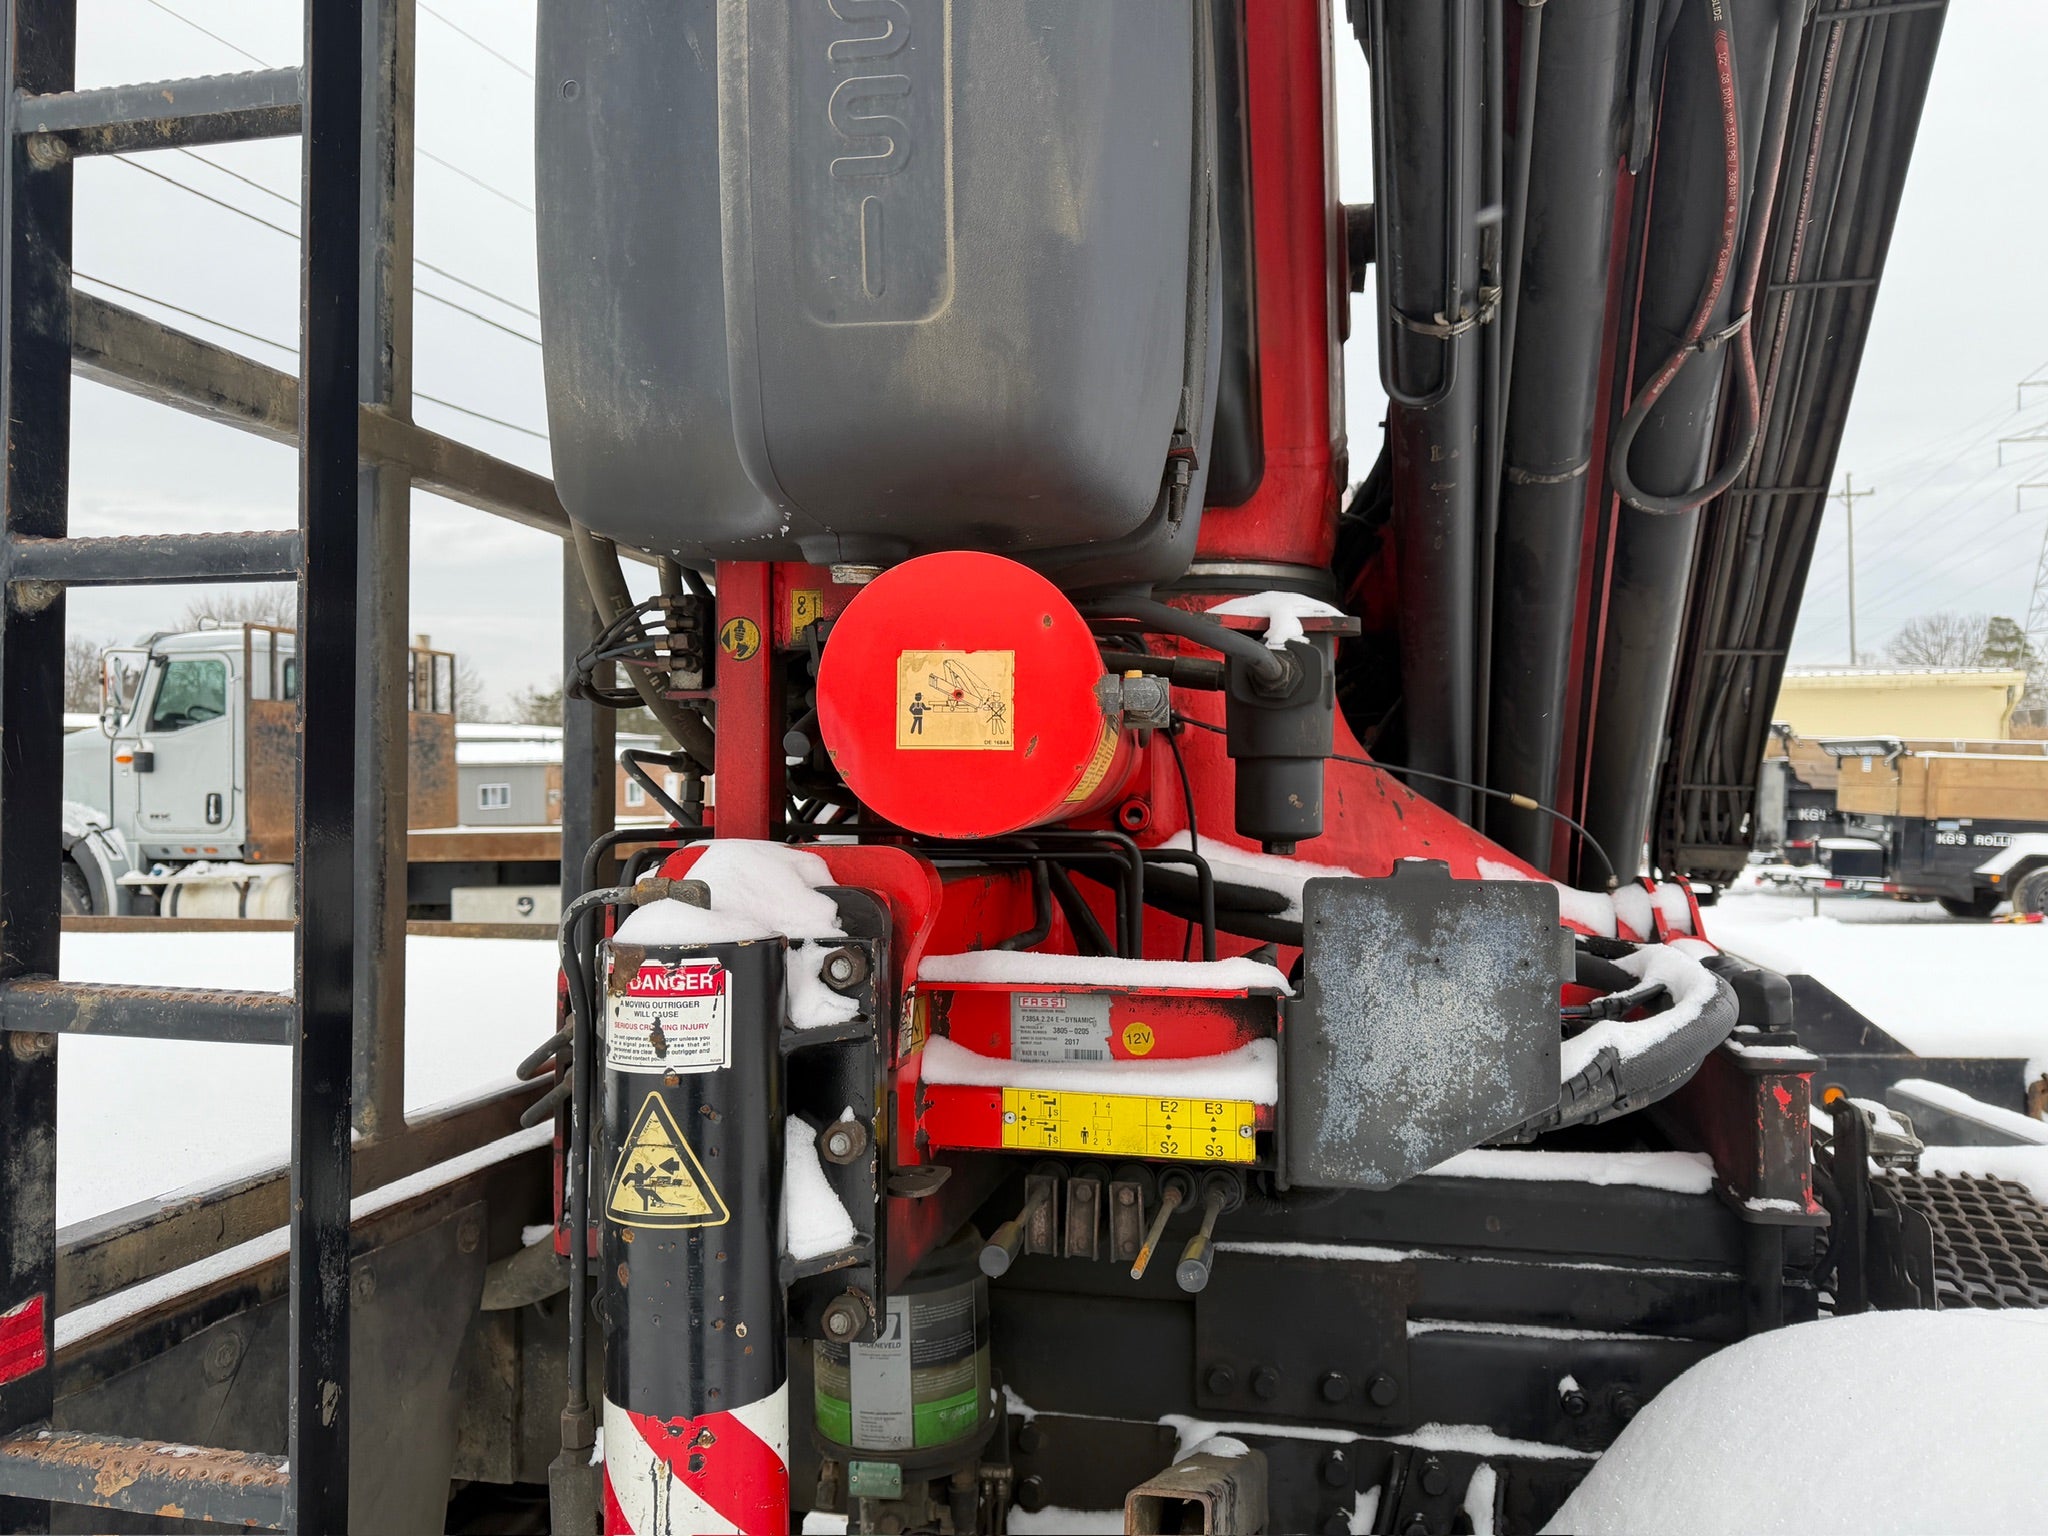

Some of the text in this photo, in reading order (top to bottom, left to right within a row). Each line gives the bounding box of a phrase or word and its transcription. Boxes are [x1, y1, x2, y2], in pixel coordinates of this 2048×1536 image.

[629, 973, 714, 992] DANGER
[624, 1000, 650, 1009] MOVING
[652, 1000, 700, 1009] OUTRIGGER
[1022, 997, 1063, 1007] FASSI
[634, 1010, 650, 1018] WILL
[614, 1022, 638, 1031] SERIOUS
[680, 1022, 710, 1031] INJURY
[1126, 1032, 1151, 1045] 12V
[1161, 1101, 1178, 1113] E2
[1205, 1103, 1223, 1115] E3
[1160, 1141, 1178, 1154] S2
[1205, 1145, 1224, 1157] S3
